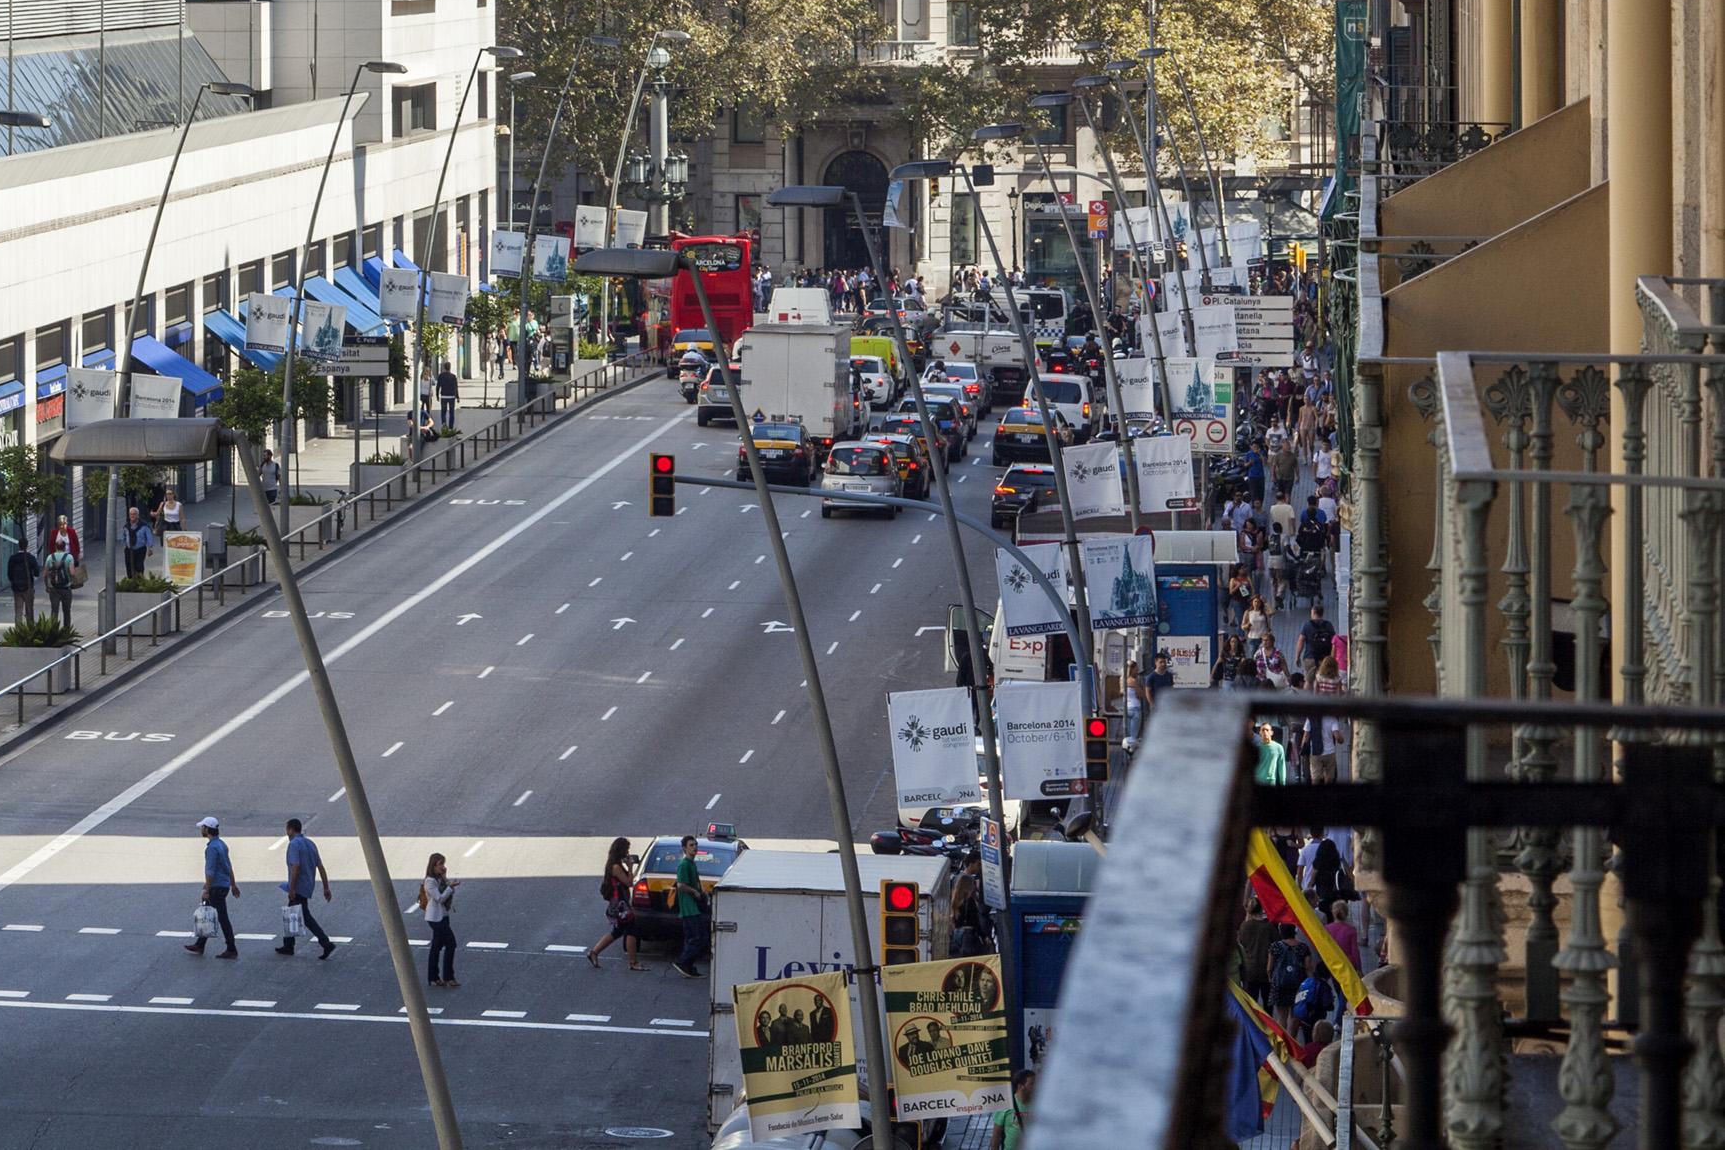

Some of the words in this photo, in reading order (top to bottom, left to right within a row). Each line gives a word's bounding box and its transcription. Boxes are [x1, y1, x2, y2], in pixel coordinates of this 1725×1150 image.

[1212, 297, 1223, 305] Pl.
[1223, 297, 1261, 306] Catalunya
[316, 364, 351, 374] Espanya
[1141, 460, 1172, 469] Barcelona
[1172, 458, 1188, 466] 2014
[449, 498, 530, 506] BUS
[1019, 621, 1066, 635] VANGUARDI
[1104, 616, 1155, 628] VANGUARDIA
[1007, 720, 1052, 731] Barcelona
[1053, 719, 1076, 729] 2014
[65, 730, 176, 743] BUS
[1006, 730, 1076, 745] October/6-10
[917, 991, 946, 1002] CHRIS
[948, 991, 974, 1002] THILE
[909, 1002, 935, 1013] BRAD
[937, 1002, 981, 1014] MEHLDAU
[782, 1041, 833, 1056] BRANFORD
[766, 1053, 833, 1072] MARSALIS
[908, 1053, 924, 1066] JOE
[910, 1059, 953, 1077] DOUGLAS
[955, 1051, 993, 1068] QUINTET
[956, 1104, 983, 1114] inspira
